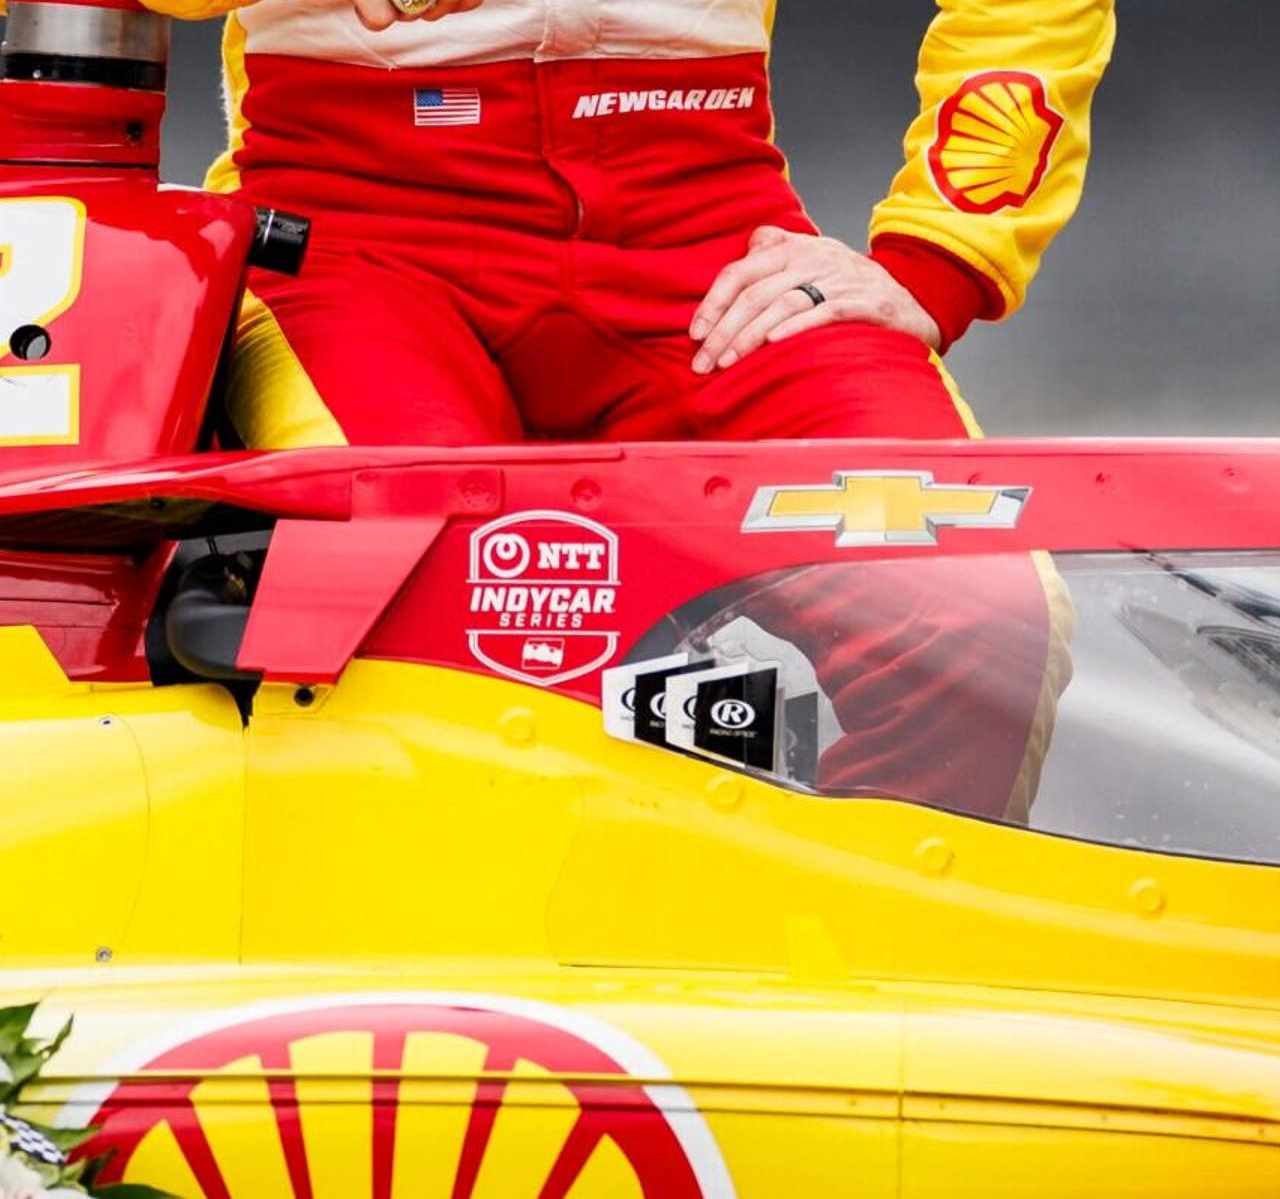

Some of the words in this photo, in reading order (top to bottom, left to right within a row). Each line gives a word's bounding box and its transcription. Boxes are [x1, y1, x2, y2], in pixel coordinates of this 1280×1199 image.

[572, 87, 755, 119] NEWGARDEN
[537, 542, 606, 568] NTT
[470, 587, 615, 615] INDYCAR
[499, 612, 584, 629] SERIES
